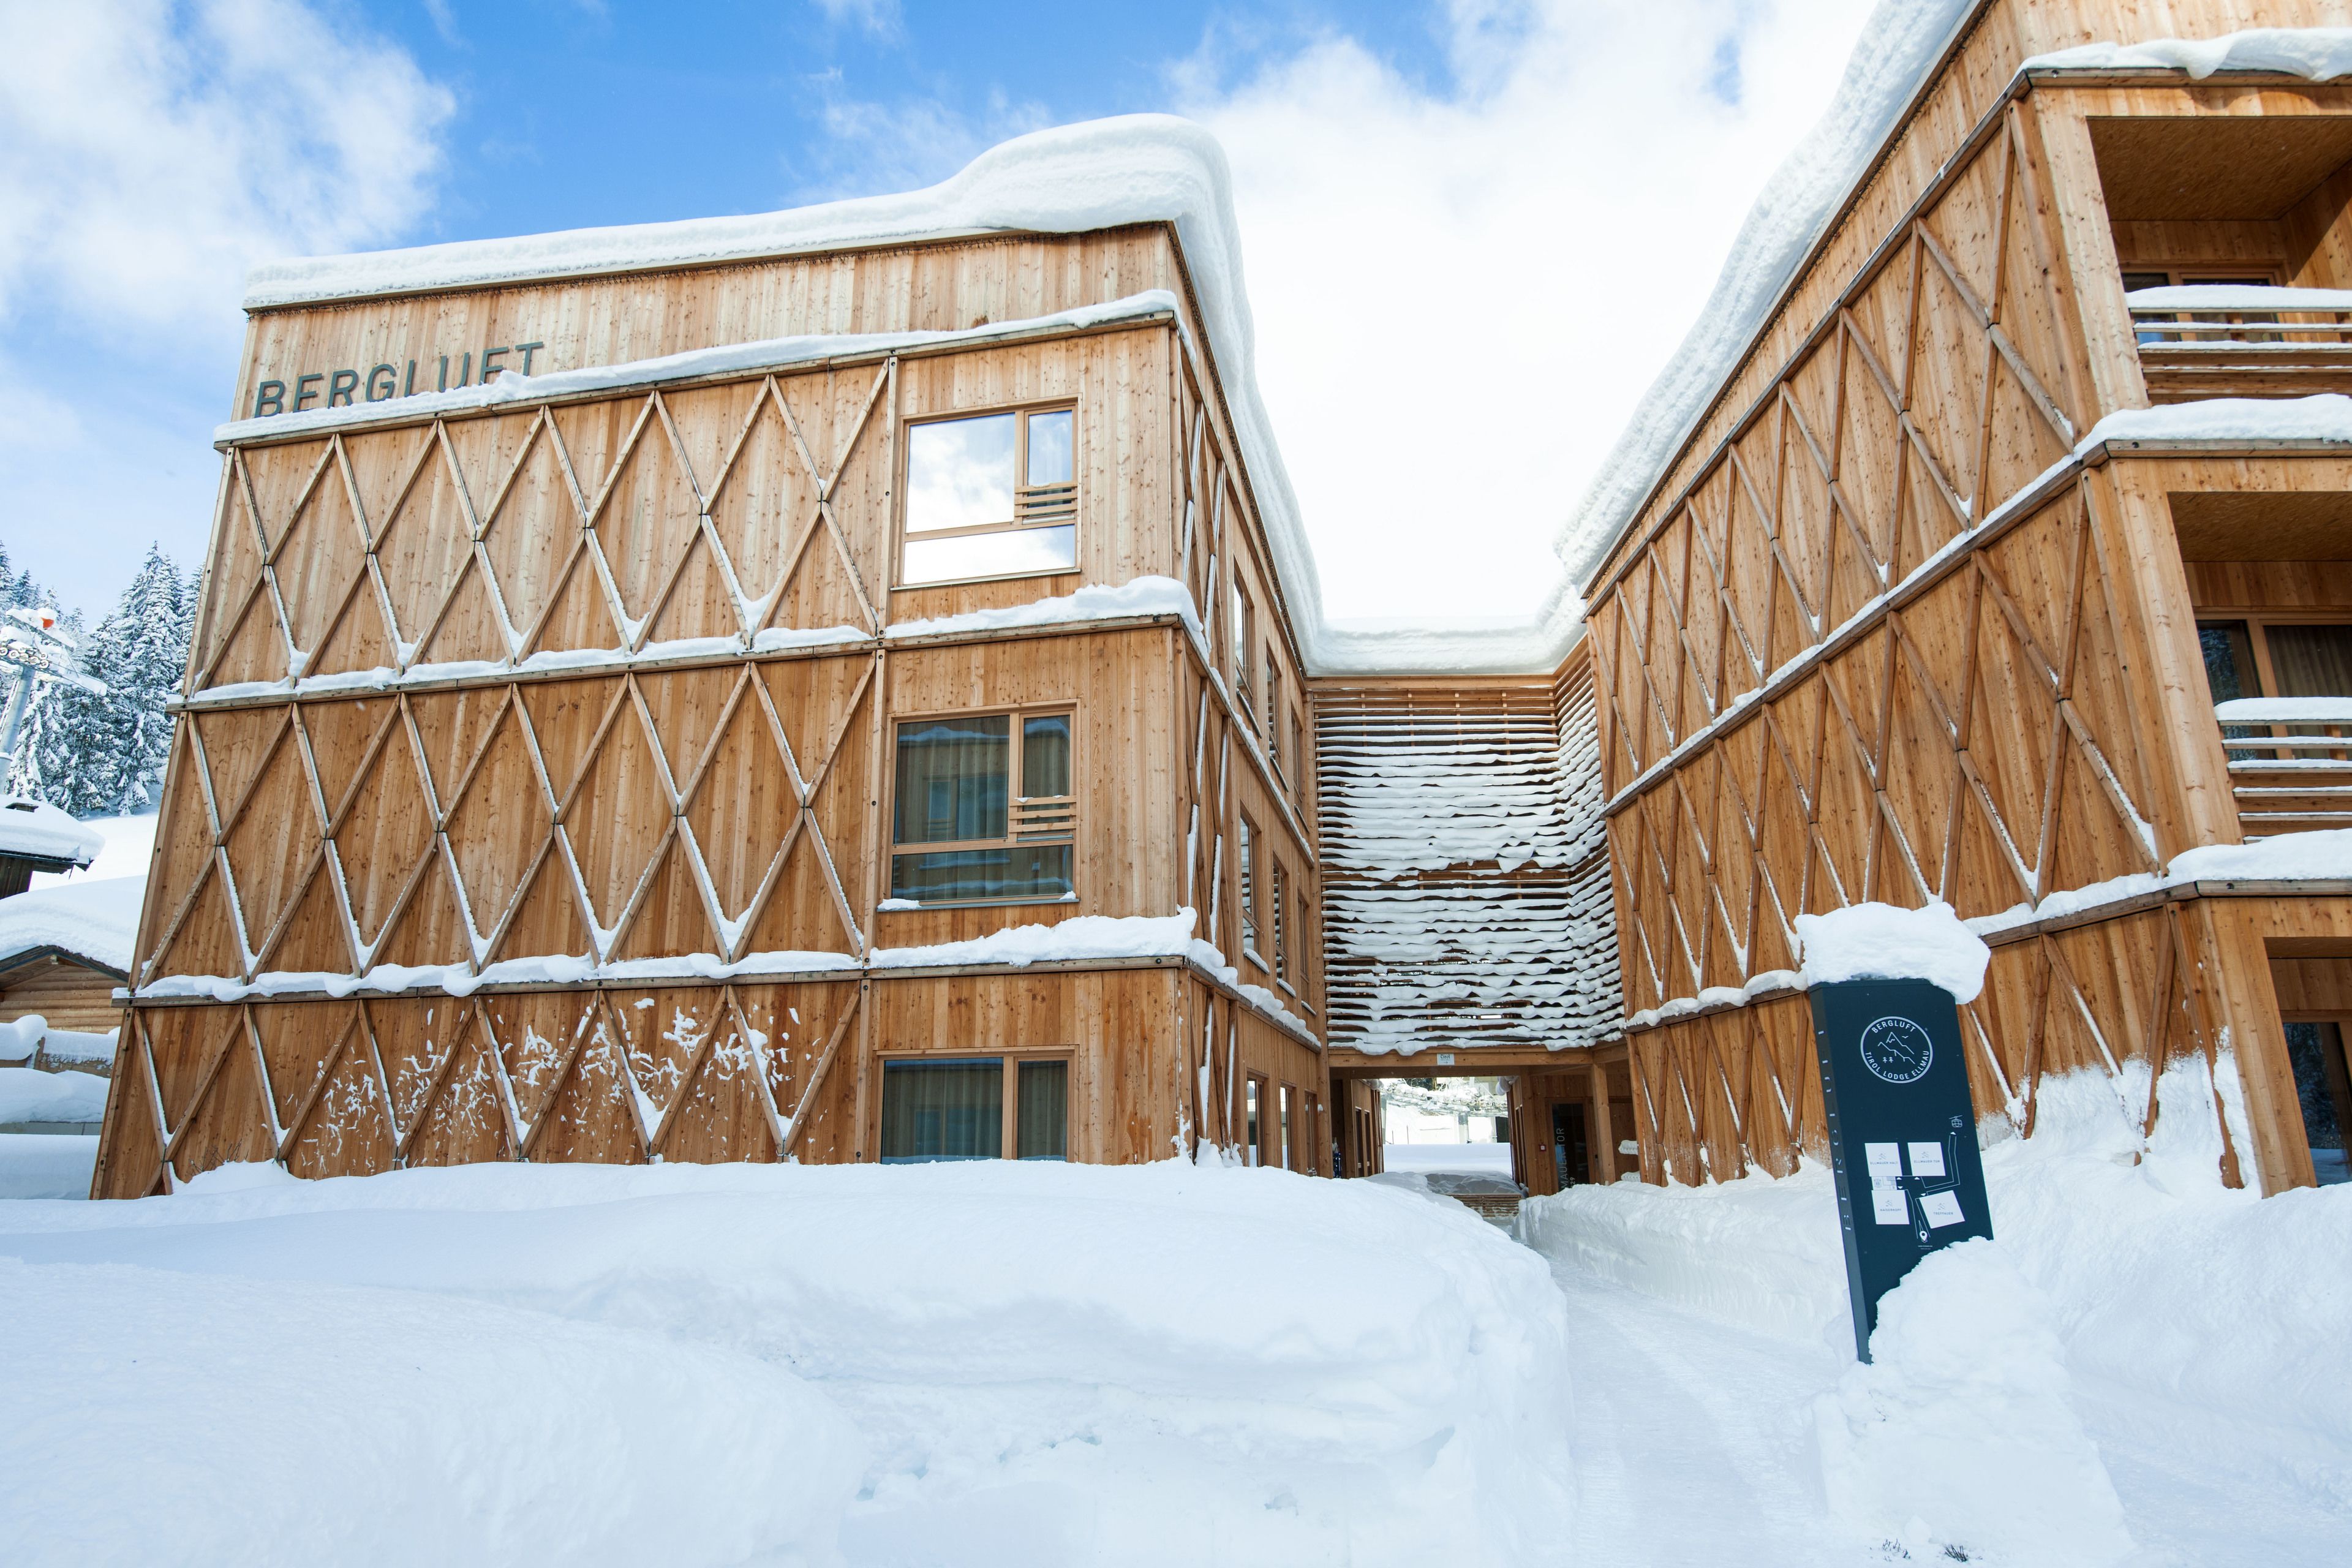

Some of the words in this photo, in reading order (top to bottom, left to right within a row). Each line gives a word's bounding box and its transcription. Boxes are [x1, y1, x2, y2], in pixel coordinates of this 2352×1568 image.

[1872, 1020, 1916, 1033] BERGLUFT
[1865, 1051, 1881, 1072] TIROL
[1883, 1071, 1910, 1080] LODGE
[1911, 1050, 1929, 1076] ELLMAU
[1556, 1127, 1566, 1147] TOR
